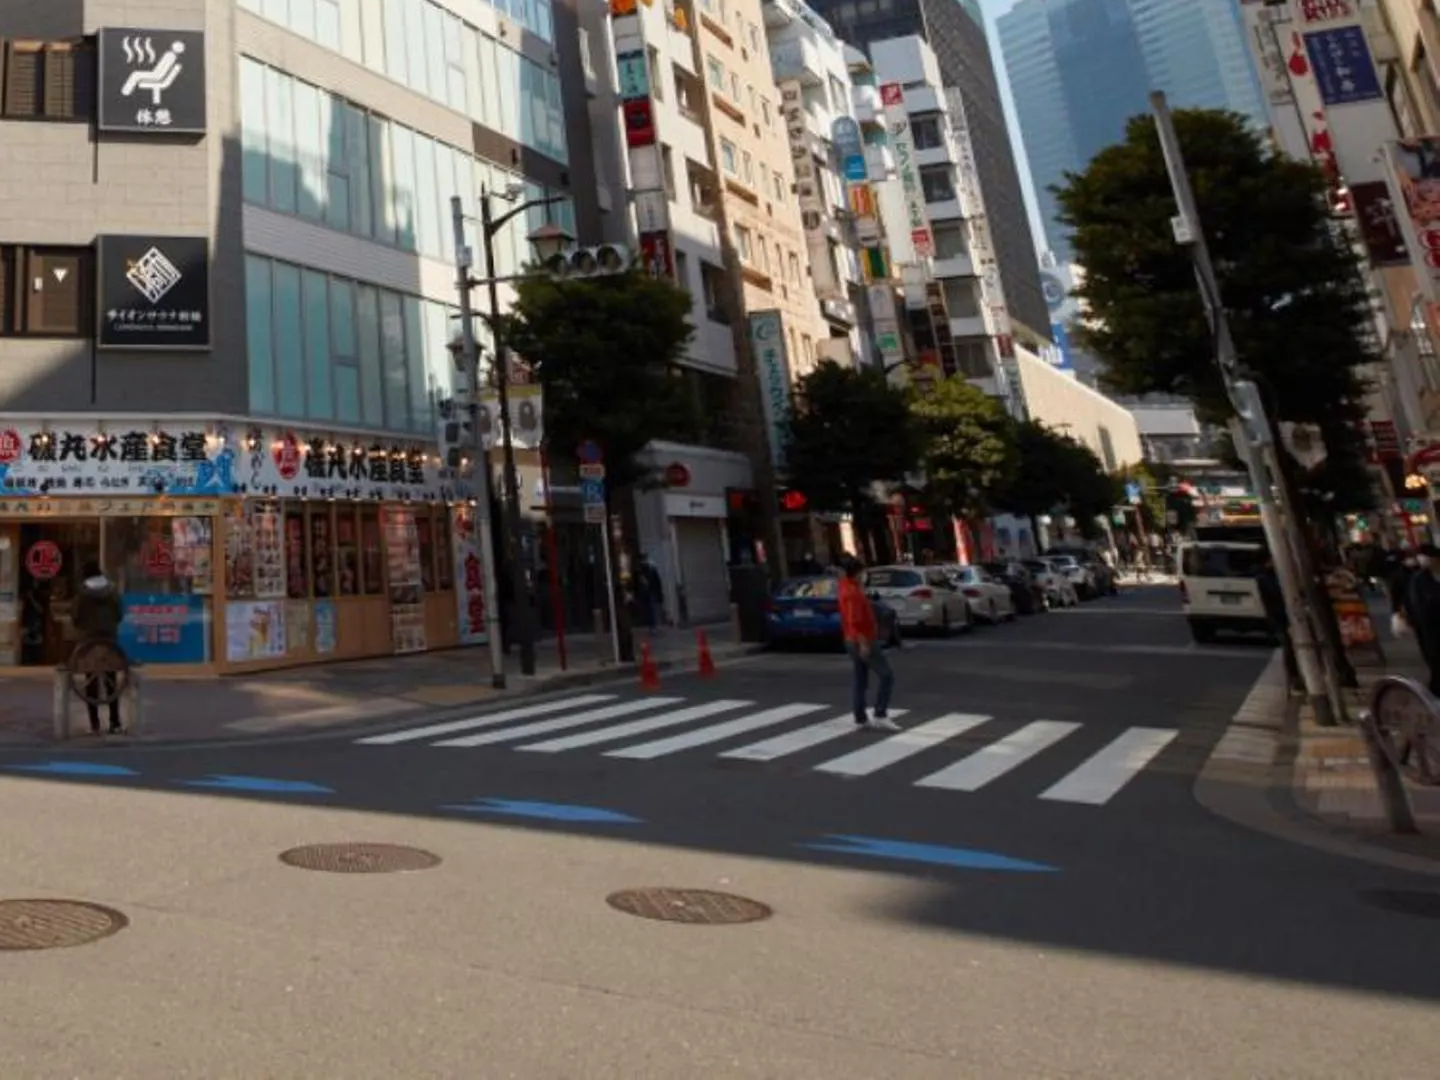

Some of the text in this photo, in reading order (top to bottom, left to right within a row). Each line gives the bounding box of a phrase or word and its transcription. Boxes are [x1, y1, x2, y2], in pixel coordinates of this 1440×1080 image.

[28, 430, 207, 462] 磯丸水産食堂
